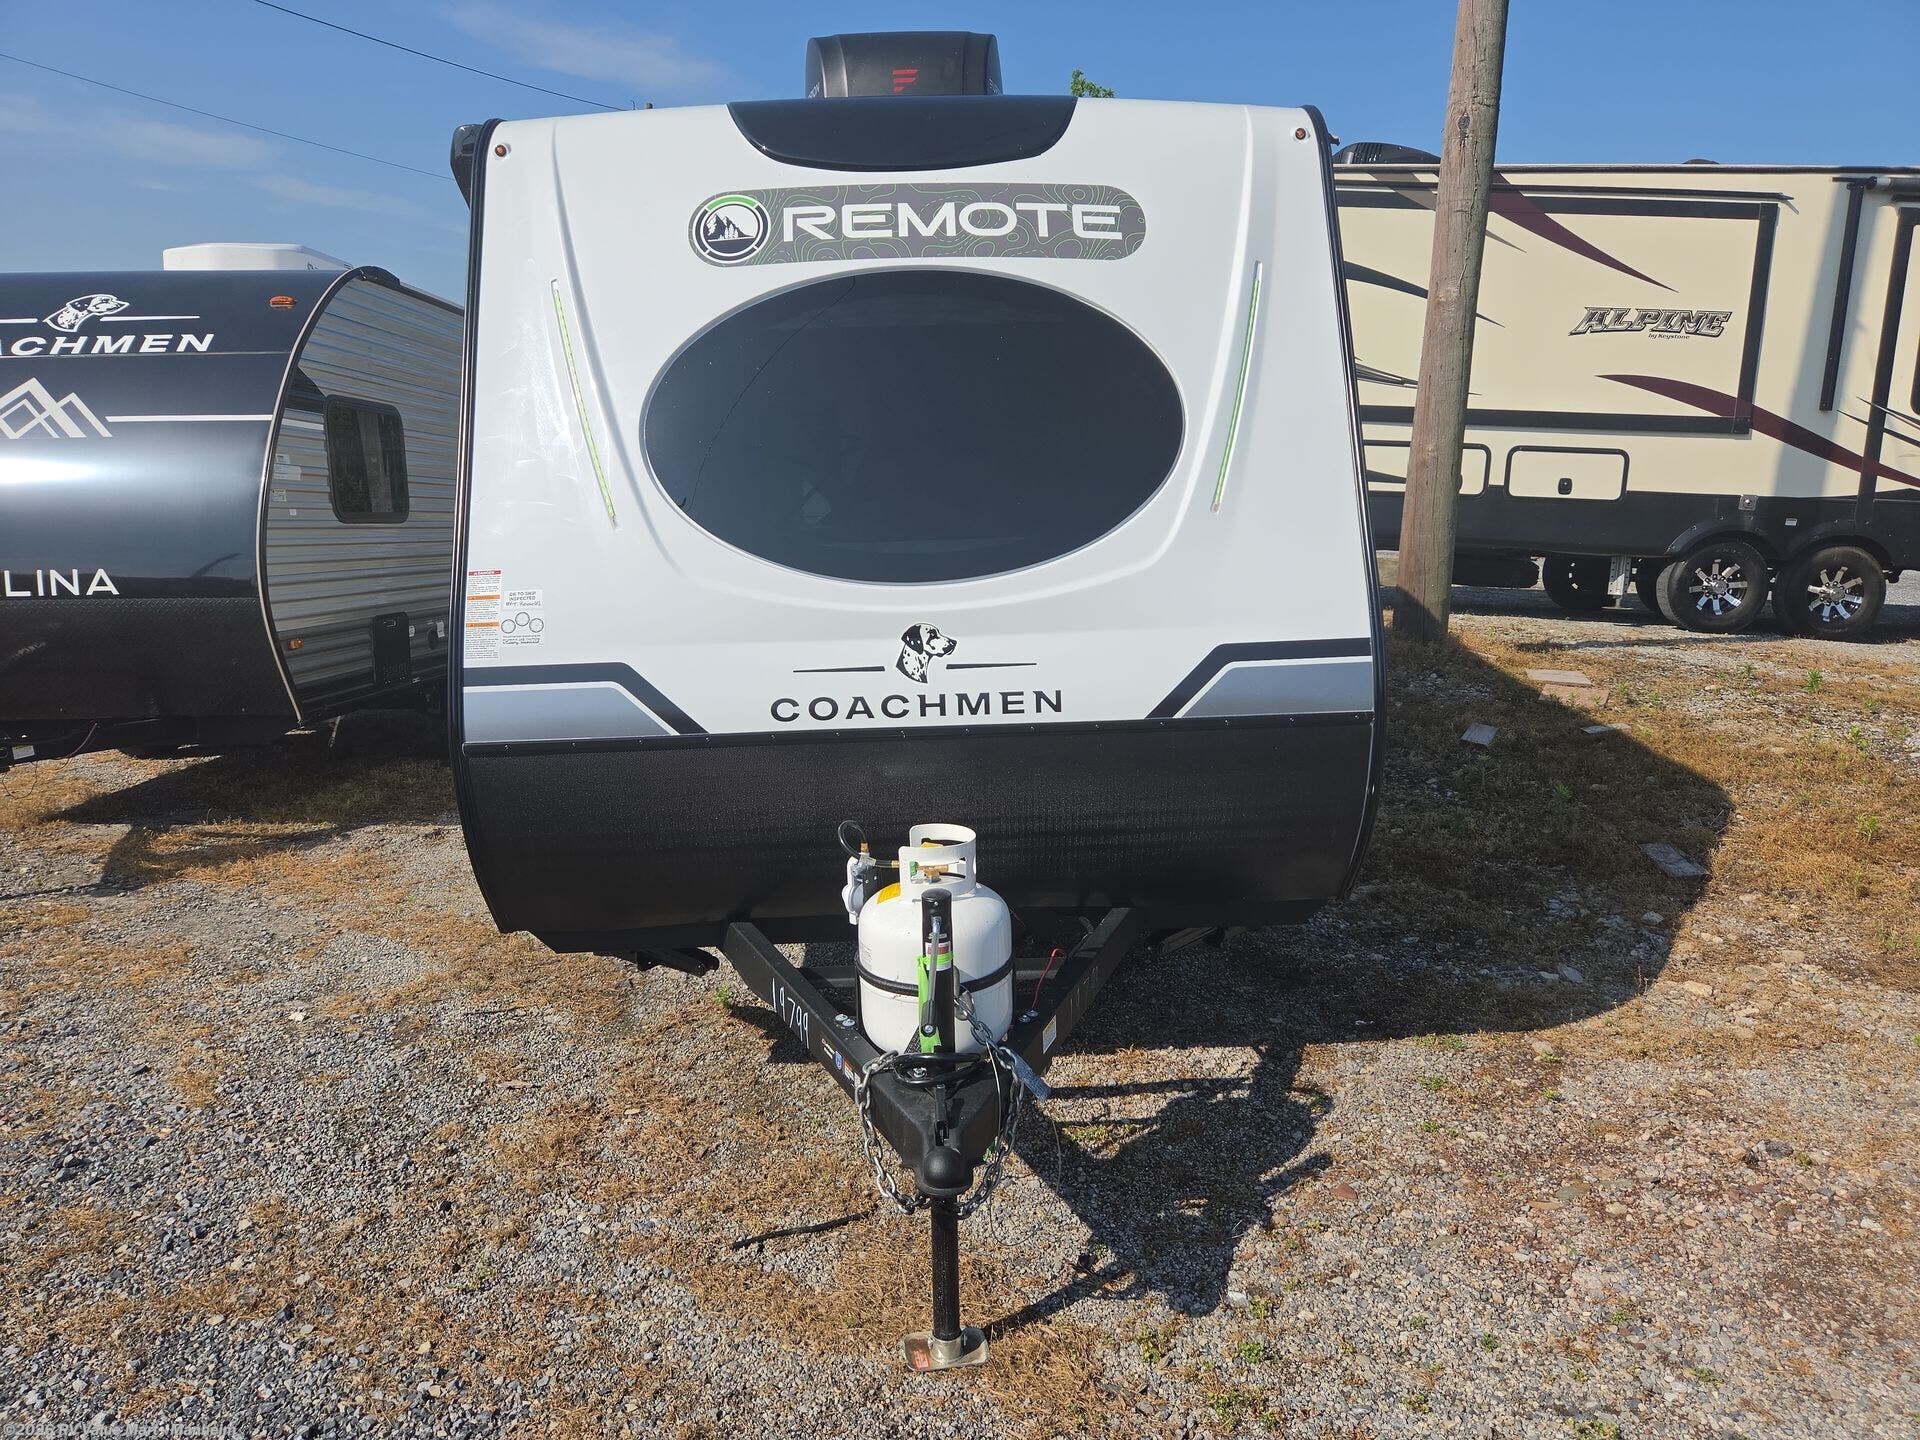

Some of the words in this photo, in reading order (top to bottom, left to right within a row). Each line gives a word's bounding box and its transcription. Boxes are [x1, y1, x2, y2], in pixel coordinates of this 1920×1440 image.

[782, 201, 1123, 242] REMOTE
[1568, 306, 1733, 337] ALPINE
[0, 333, 214, 357] CHMEN
[4, 568, 120, 597] LINA
[770, 690, 1062, 722] COACHMEN
